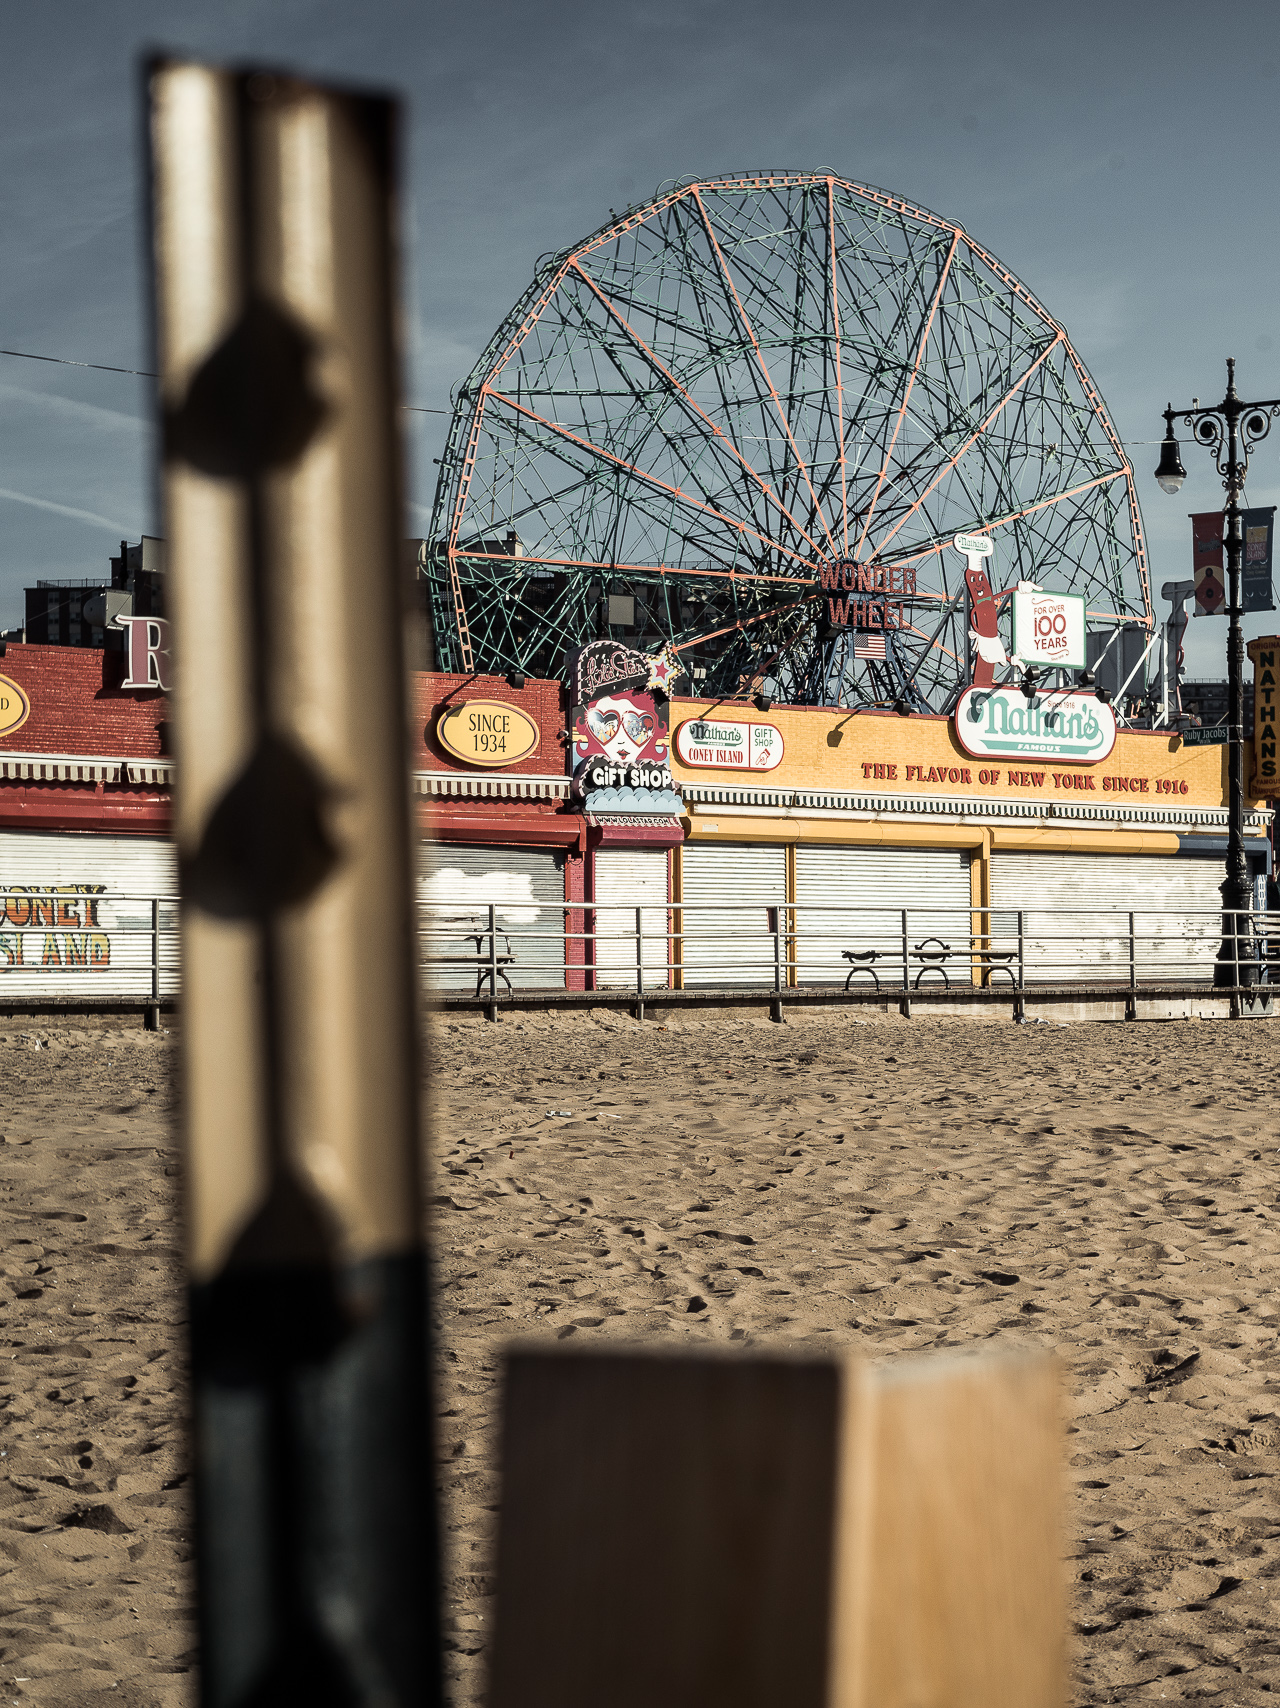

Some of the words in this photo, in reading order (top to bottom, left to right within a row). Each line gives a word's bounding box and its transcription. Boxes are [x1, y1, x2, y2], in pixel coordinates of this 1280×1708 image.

[818, 561, 917, 595] WONDER
[828, 597, 912, 630] WHEEL
[1033, 606, 1047, 615] FOR
[1048, 604, 1065, 614] OVER
[1033, 613, 1067, 637] 100
[1033, 636, 1068, 650] YEARS
[1063, 701, 1076, 709] 1916
[1259, 651, 1277, 777] NATHANS
[468, 713, 511, 733] SINCE
[970, 691, 1101, 741] Nathan's
[688, 723, 743, 742] Nathan's
[754, 728, 774, 739] GIFT
[754, 738, 774, 747] SHOP
[1183, 729, 1201, 741] Ruby
[1202, 727, 1227, 739] Jacobs
[473, 733, 507, 753] 1934
[1017, 743, 1062, 752] FAMOUS
[688, 747, 714, 762] CONEY
[716, 749, 744, 764] ISLAND
[630, 768, 672, 788] SHOP
[861, 762, 898, 780] THE
[905, 764, 973, 785] FLAVOR
[978, 768, 1001, 786] OF
[1007, 770, 1046, 788] NEW
[1052, 772, 1097, 791] YORK
[1102, 776, 1150, 793] SINCE
[1154, 778, 1189, 795] 1916
[0, 884, 108, 928] ONEY
